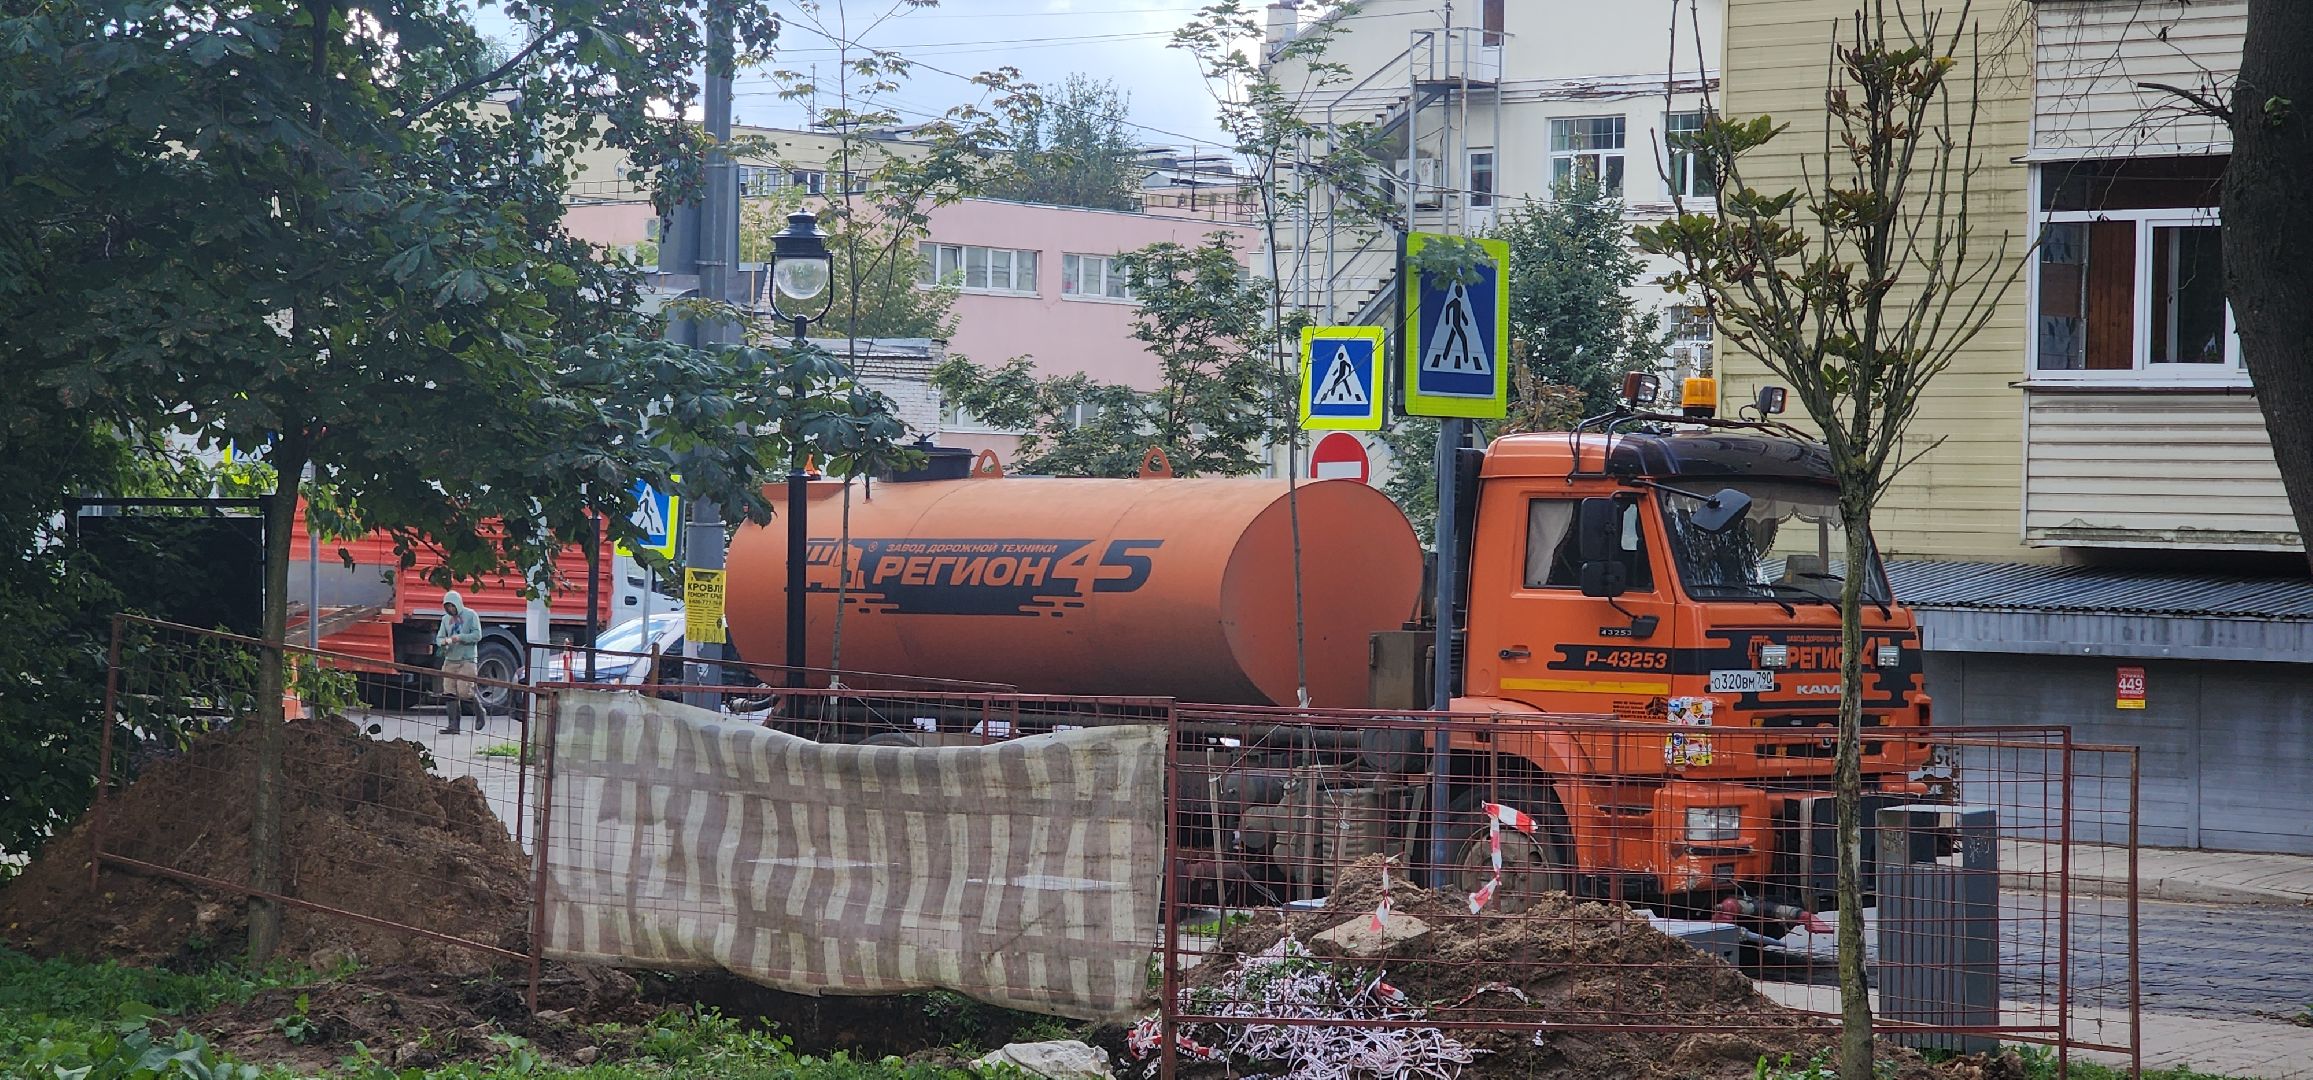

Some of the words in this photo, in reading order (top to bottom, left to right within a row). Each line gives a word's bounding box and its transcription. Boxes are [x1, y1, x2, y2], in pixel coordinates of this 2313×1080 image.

[886, 543, 926, 554] ЗАВОД
[927, 543, 998, 554] ДОРОЖНОЙ
[1001, 544, 1059, 553] ТЕХНИКИ
[872, 556, 1051, 586] РЕГИОН
[1051, 539, 1165, 593] 45
[1585, 650, 1668, 669] Р-43253
[1786, 646, 1843, 669] РЕГИО
[1714, 674, 1755, 690] О320ВМ
[1756, 672, 1772, 684] 790
[1796, 684, 1843, 695] КАМ
